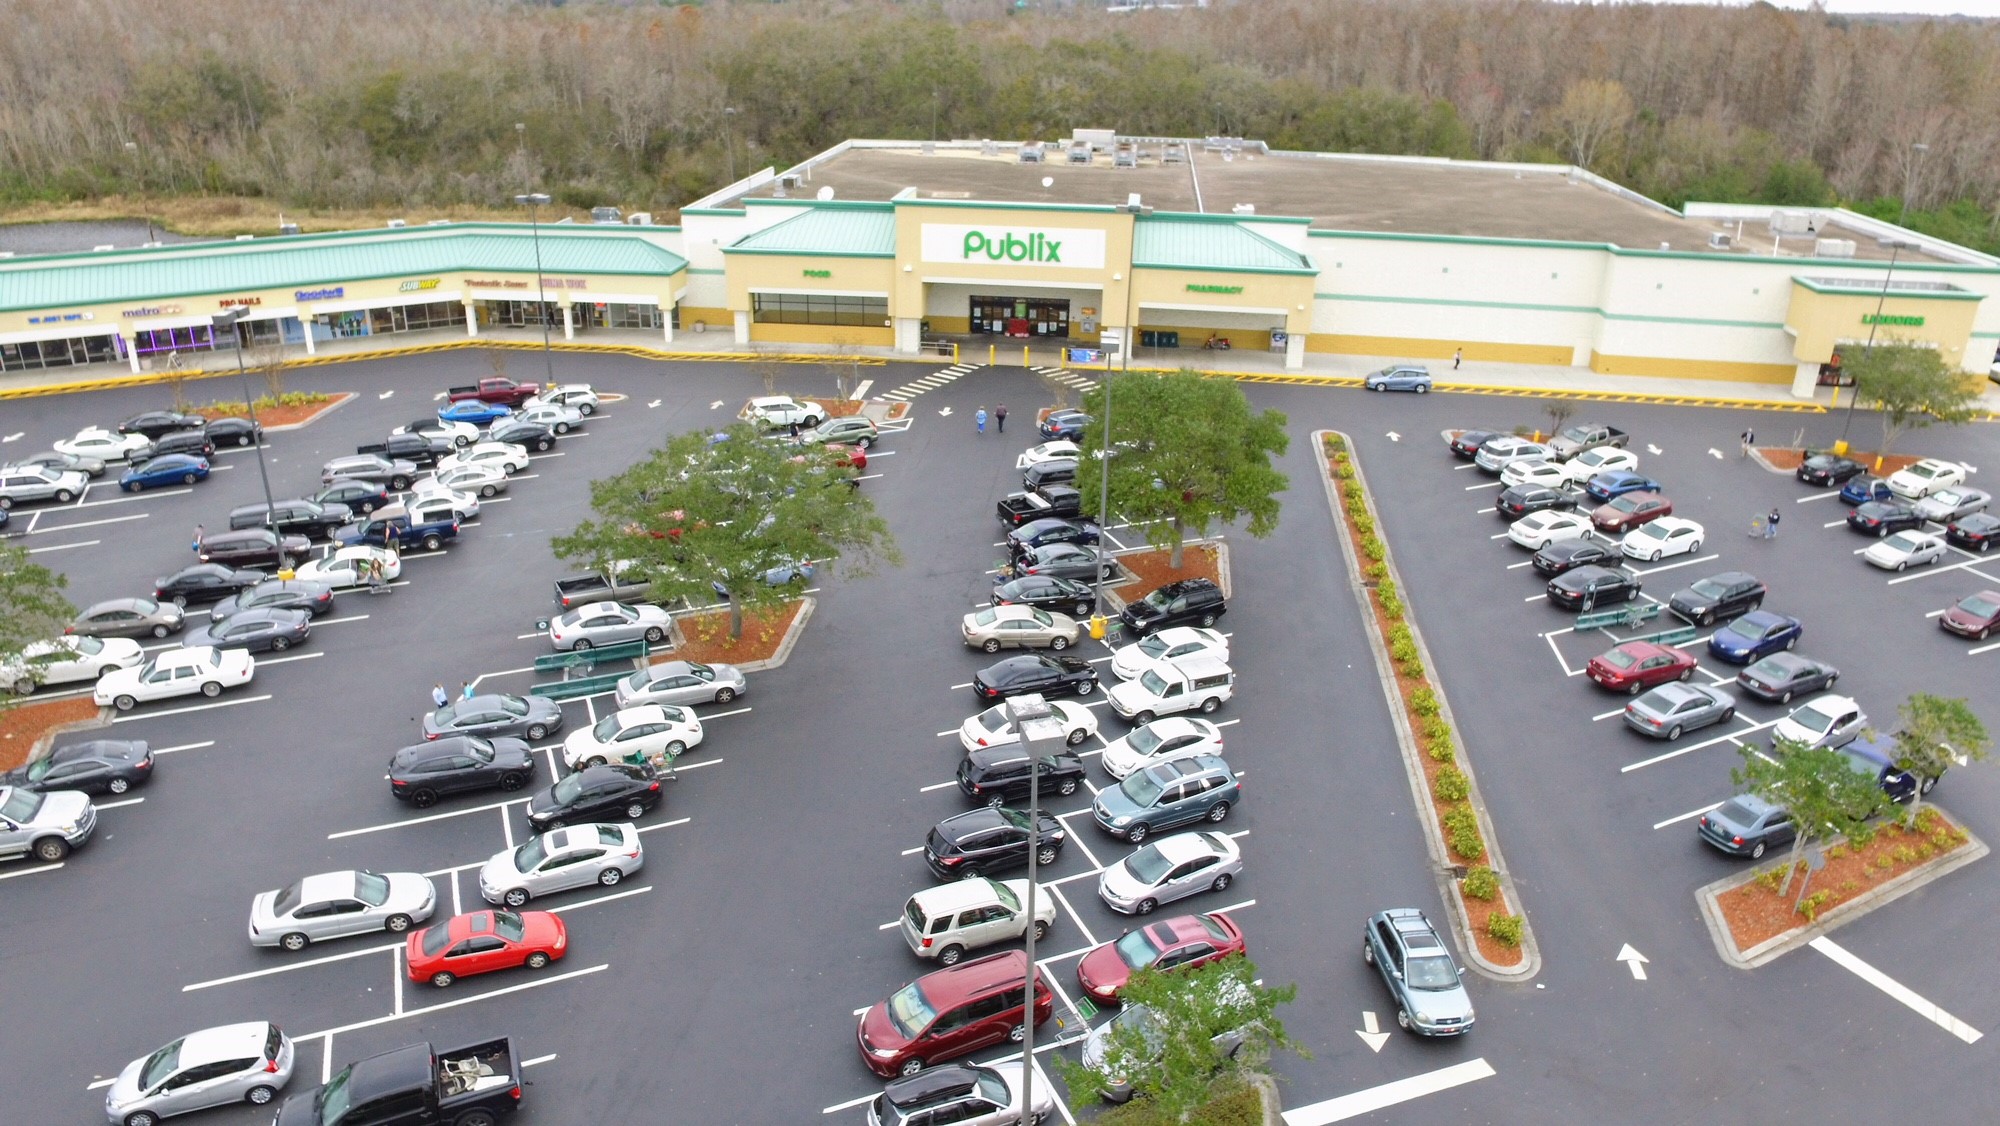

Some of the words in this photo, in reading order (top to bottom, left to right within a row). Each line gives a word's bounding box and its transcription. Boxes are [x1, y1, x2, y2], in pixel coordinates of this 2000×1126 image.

[963, 230, 1062, 263] Publix
[803, 269, 831, 278] FOOD
[400, 279, 440, 292] SUBWAY
[1186, 284, 1244, 295] PHARMACY
